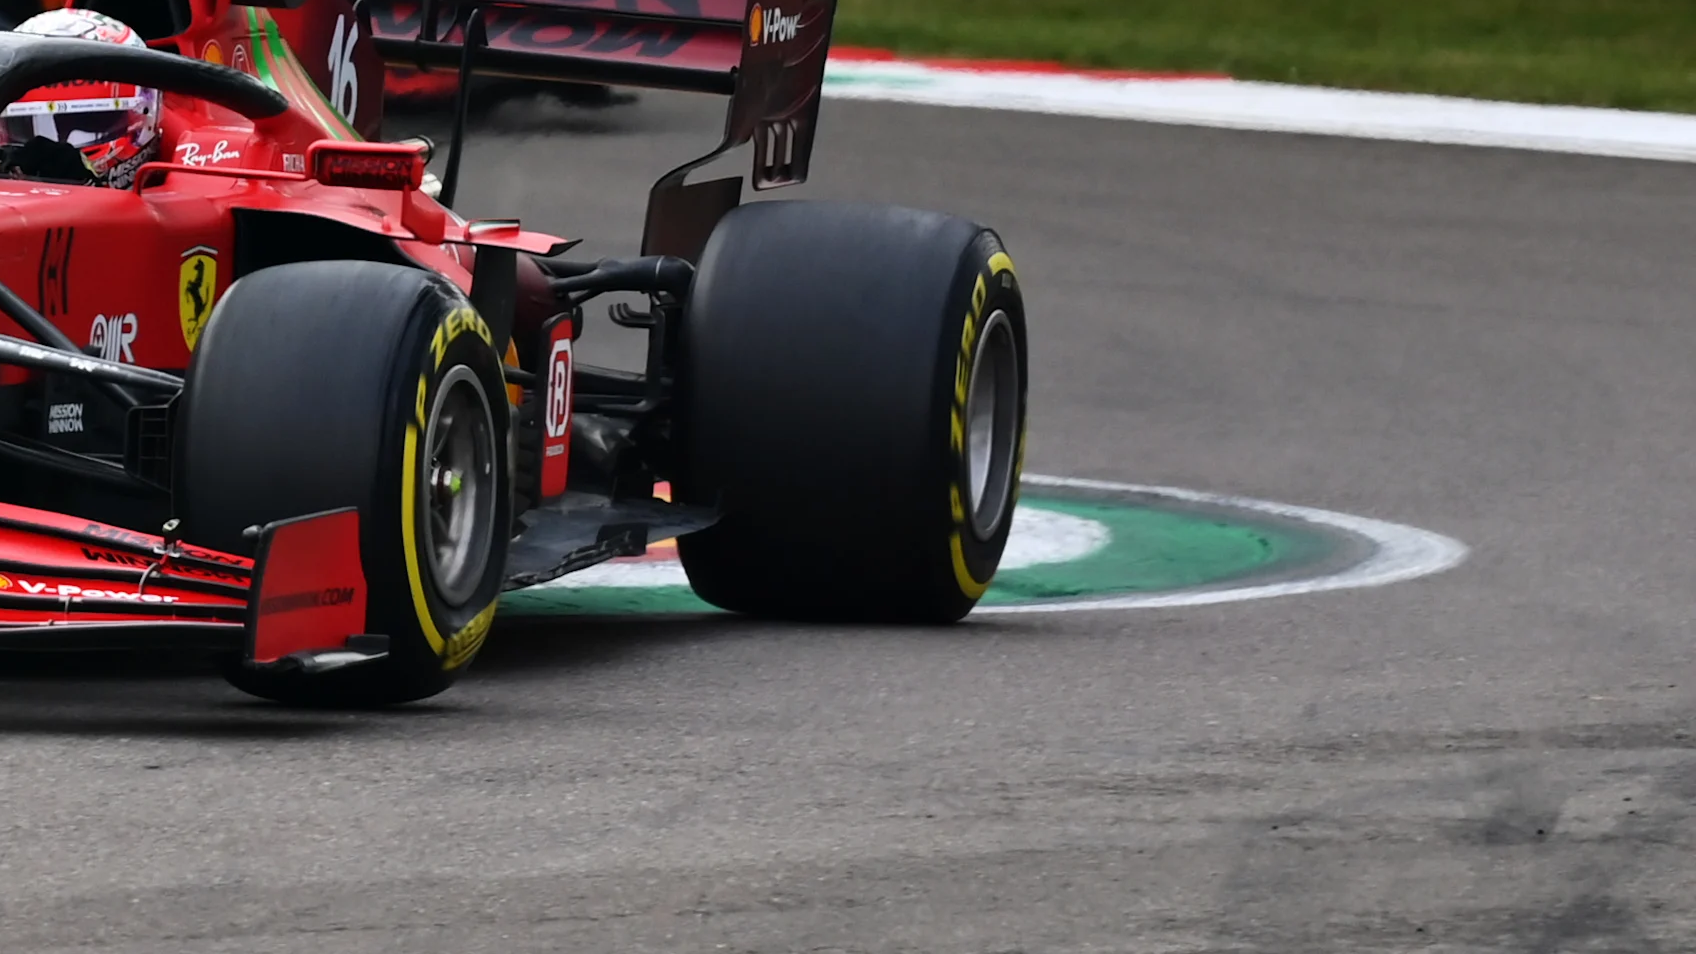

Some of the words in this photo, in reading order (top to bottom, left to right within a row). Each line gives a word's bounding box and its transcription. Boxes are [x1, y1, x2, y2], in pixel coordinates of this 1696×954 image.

[763, 7, 802, 45] V-Pow
[328, 14, 359, 125] 16
[175, 140, 240, 167] Ray-Ban
[430, 307, 493, 374] ZERO
[950, 272, 986, 453] ZERO
[18, 580, 179, 603] V-Power
